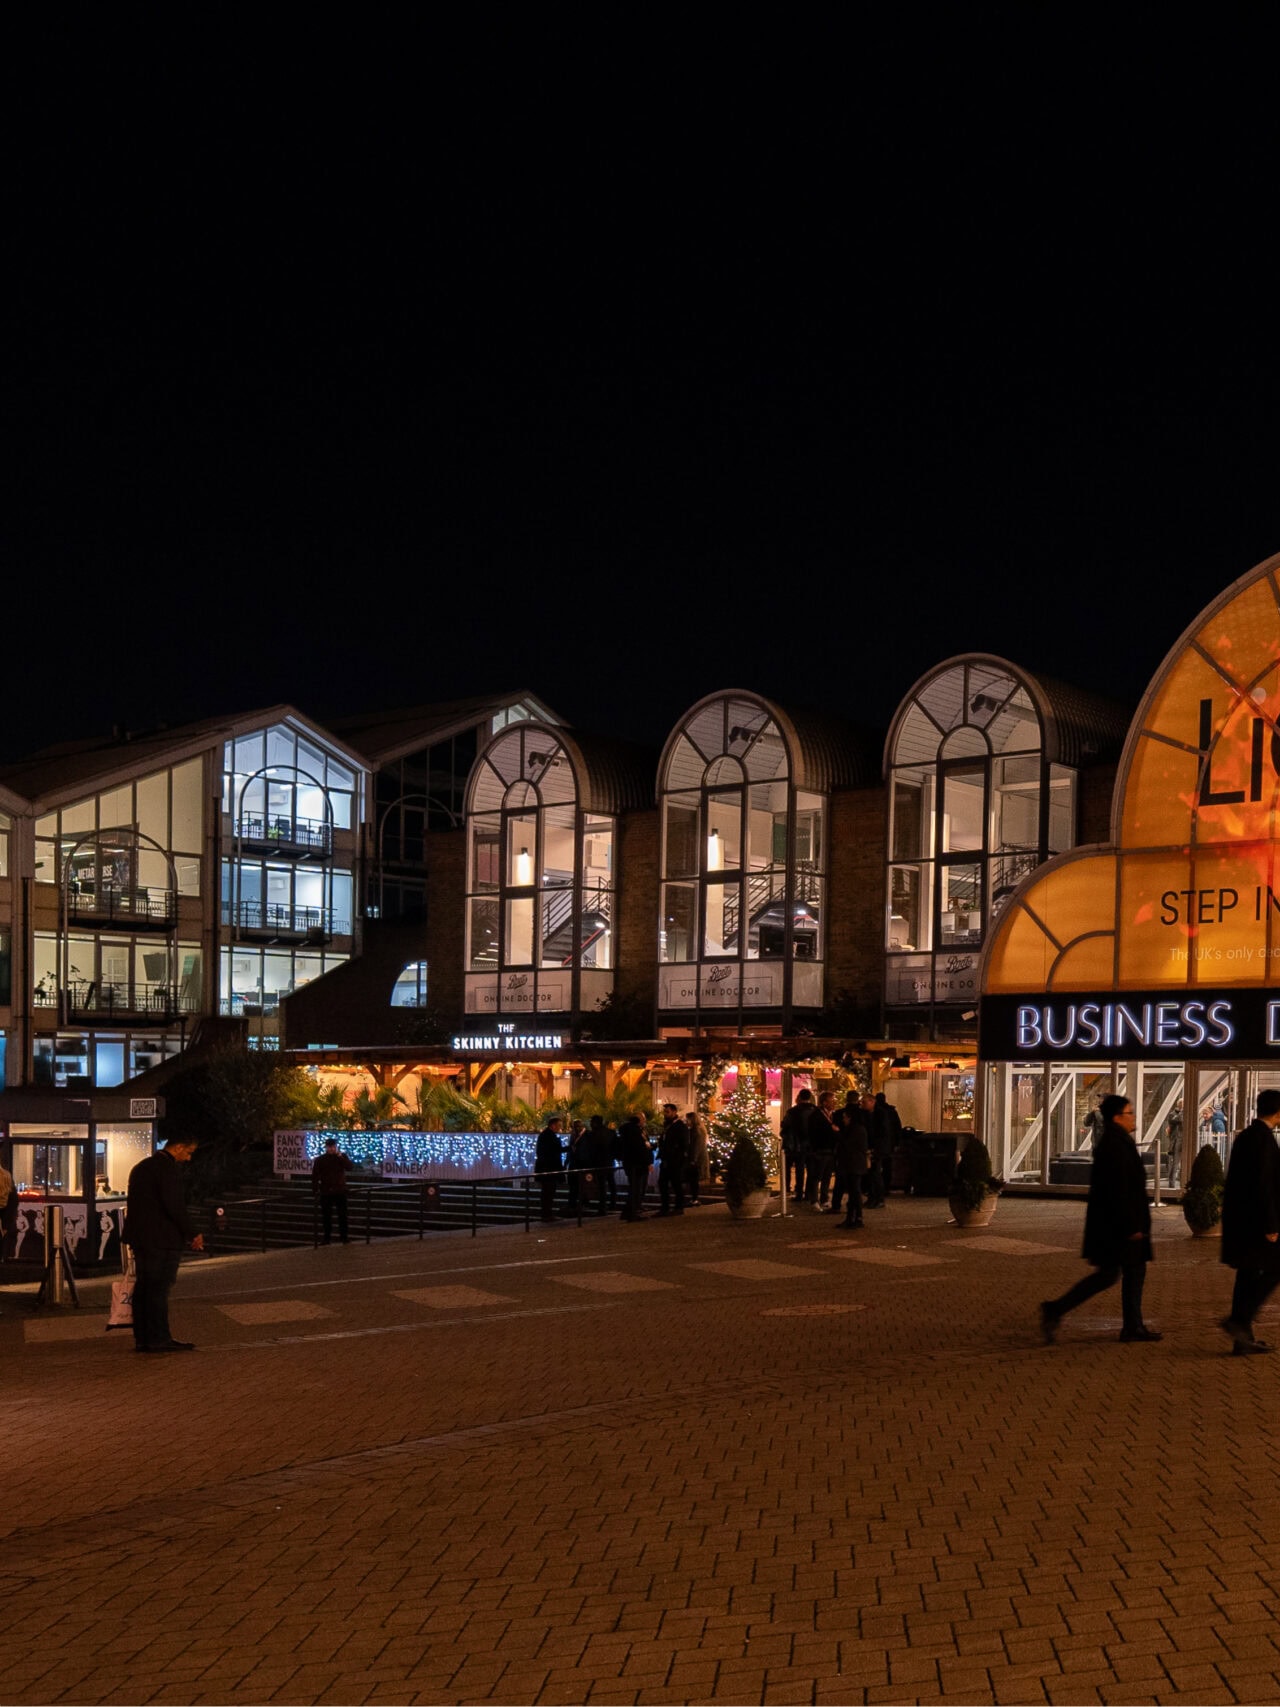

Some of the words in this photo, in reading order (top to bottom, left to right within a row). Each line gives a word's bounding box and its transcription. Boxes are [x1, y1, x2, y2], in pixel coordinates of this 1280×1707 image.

[1160, 888, 1239, 926] STEP
[1194, 947, 1222, 961] UK's
[1227, 946, 1253, 962] only
[484, 994, 514, 1003] ONINE
[498, 1024, 515, 1033] THE
[1016, 1001, 1234, 1048] BUSINESS
[453, 1037, 500, 1050] SKINNY
[505, 1035, 562, 1049] KITCHEN
[277, 1135, 306, 1146] FANCY
[277, 1147, 301, 1158] SOME
[385, 1161, 428, 1175] DINNER?
